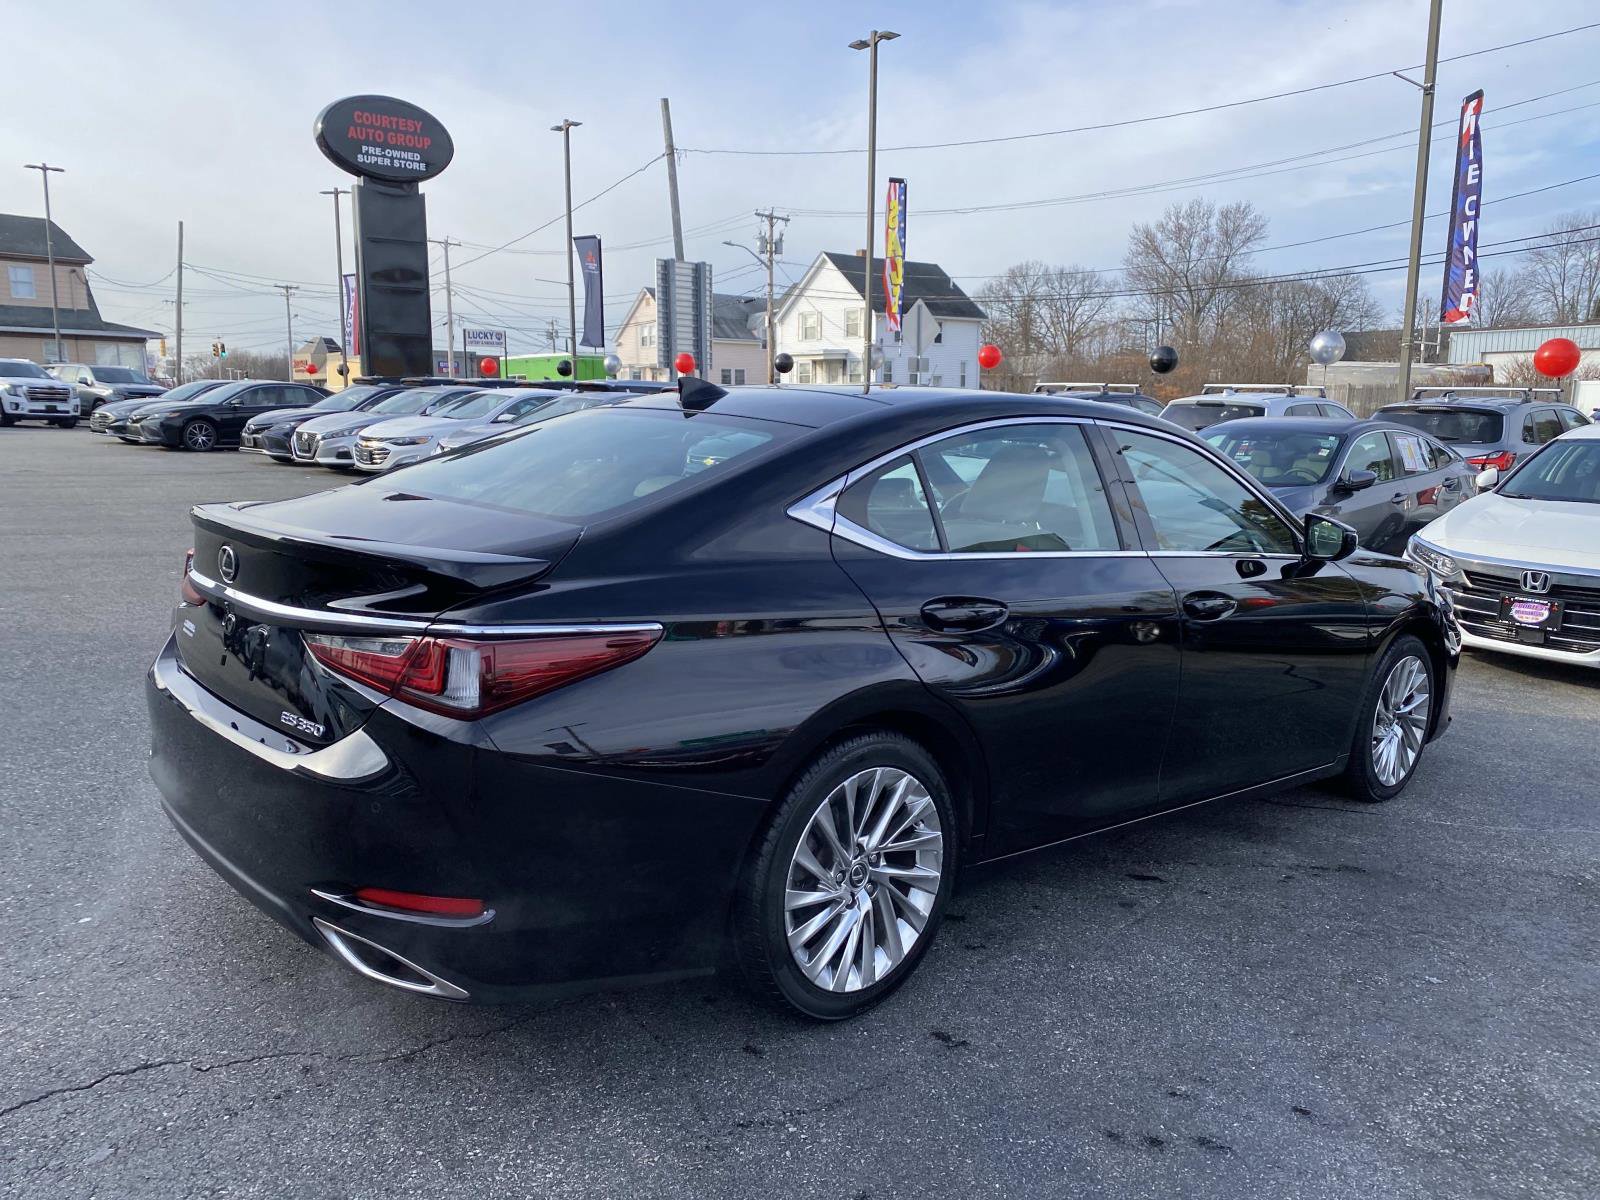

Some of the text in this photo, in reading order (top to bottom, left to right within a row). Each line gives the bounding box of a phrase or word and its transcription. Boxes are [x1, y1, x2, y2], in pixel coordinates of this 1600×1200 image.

[353, 111, 423, 133] COURTESY
[347, 126, 432, 149] AUTO GROUP
[361, 145, 421, 161] PRE-OWNED
[357, 154, 427, 171] SUPER STORE
[467, 331, 494, 340] LUCKY
